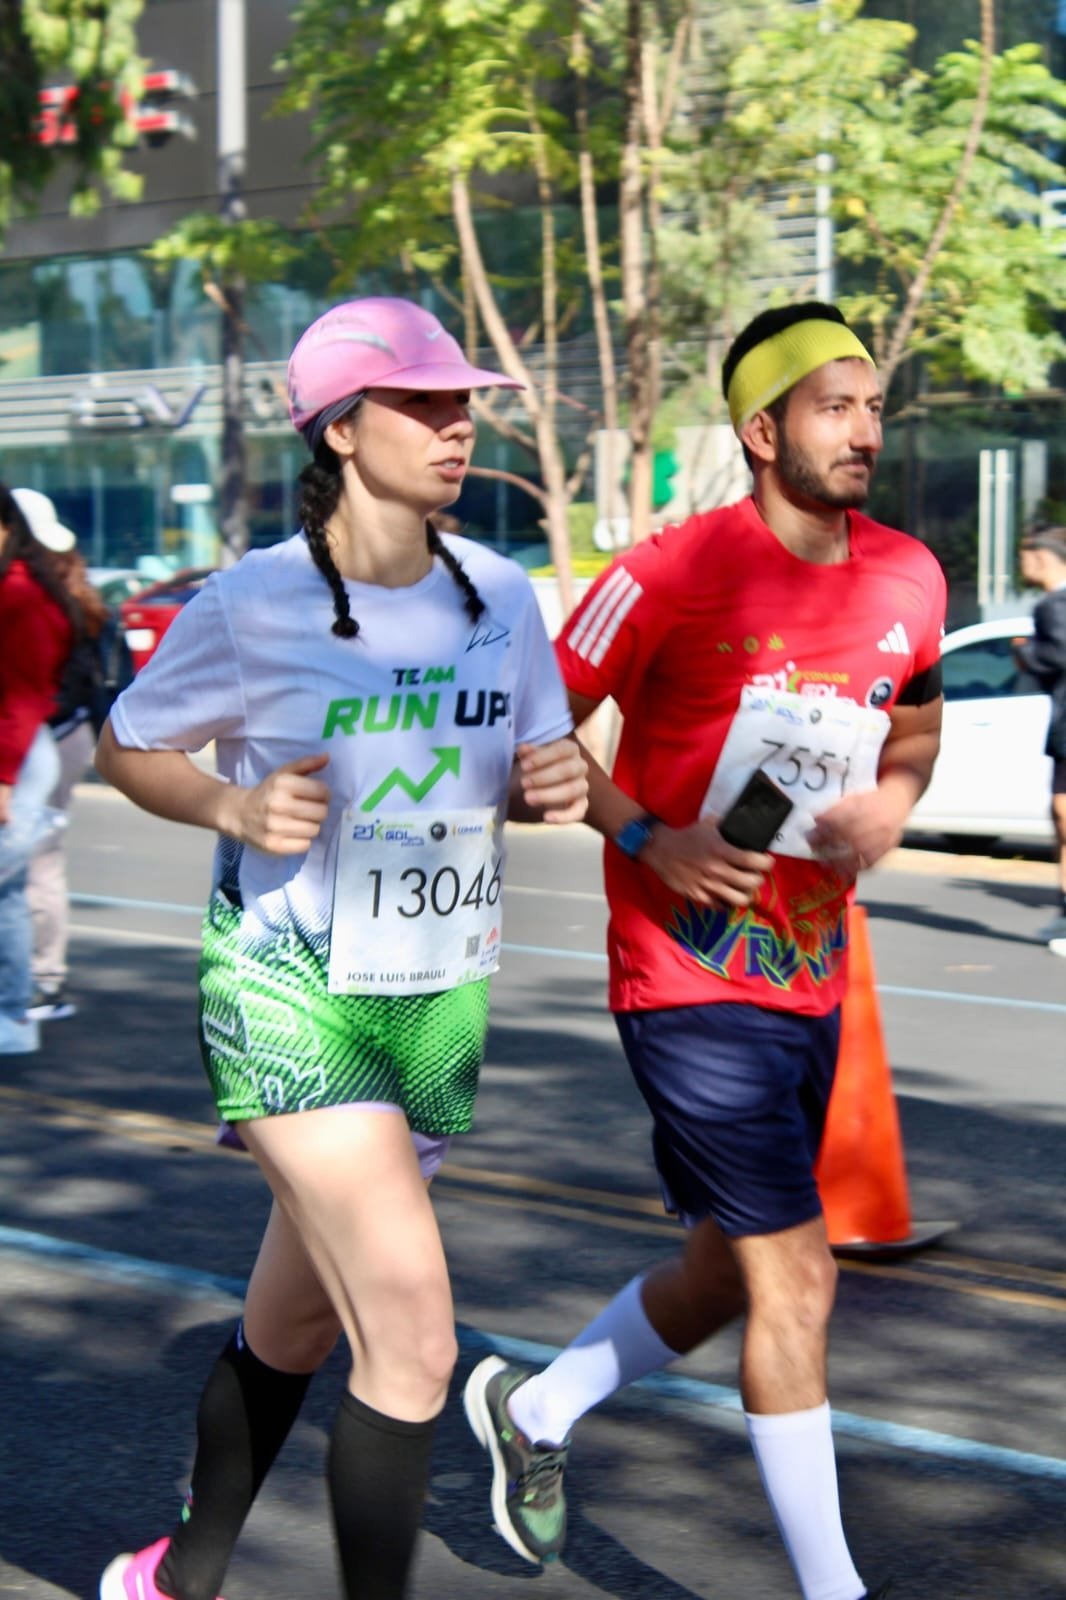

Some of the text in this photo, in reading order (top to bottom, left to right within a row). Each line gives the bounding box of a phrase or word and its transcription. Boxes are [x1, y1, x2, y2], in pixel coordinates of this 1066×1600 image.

[392, 664, 456, 686] TEAM
[321, 691, 440, 740] RUN
[367, 858, 502, 919] 13046
[346, 968, 446, 983] JOSE LUIS BRAULI
